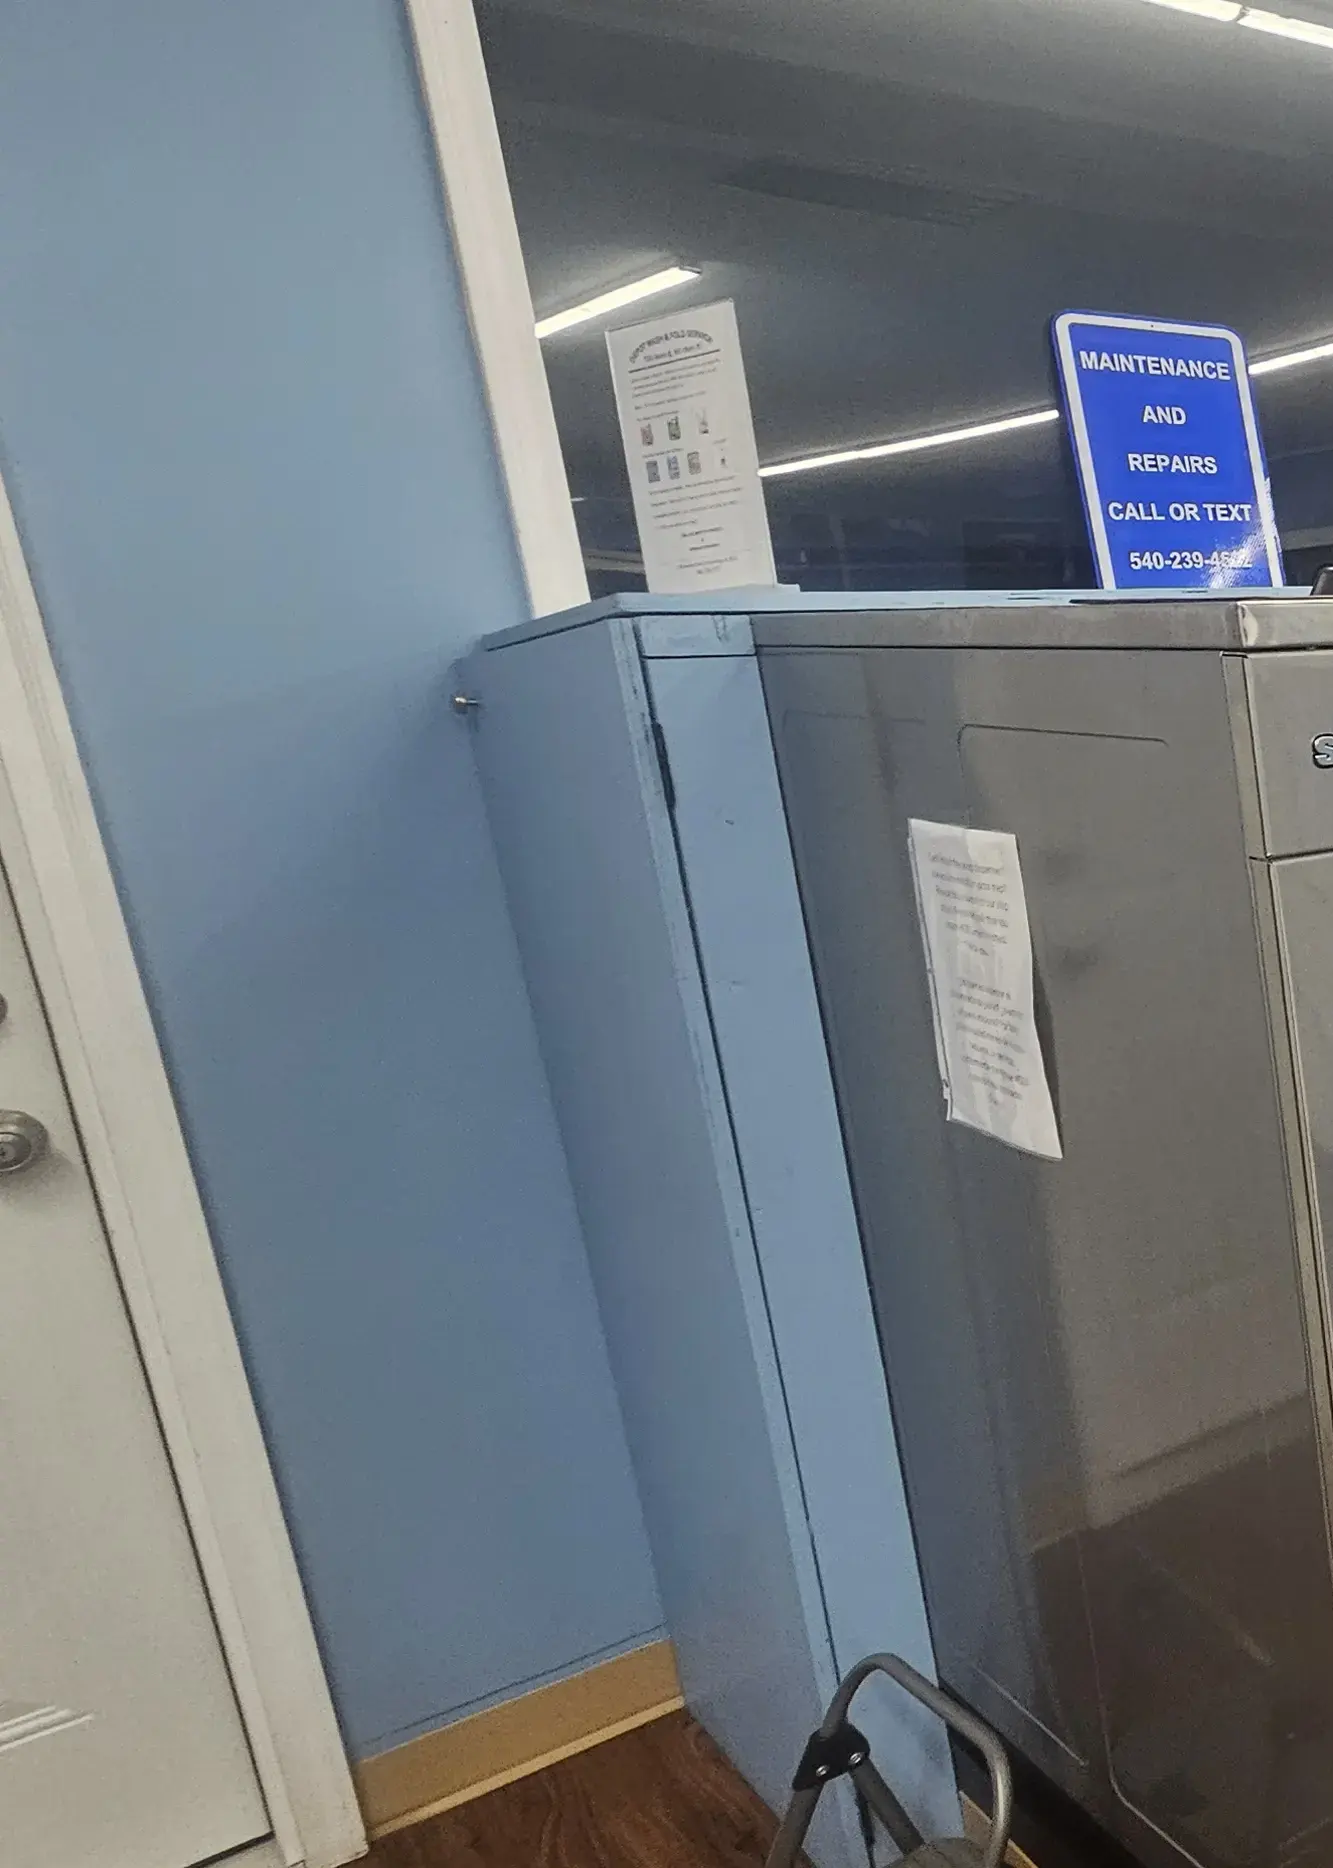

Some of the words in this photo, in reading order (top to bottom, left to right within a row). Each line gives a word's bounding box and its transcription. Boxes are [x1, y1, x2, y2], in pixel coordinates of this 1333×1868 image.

[1079, 350, 1232, 381] MAINTENANCE
[1142, 405, 1187, 425] AND
[1127, 453, 1219, 474] REPAIRS
[1108, 502, 1166, 521] CALL
[1168, 503, 1201, 521] OR
[1202, 503, 1252, 522] TEXT
